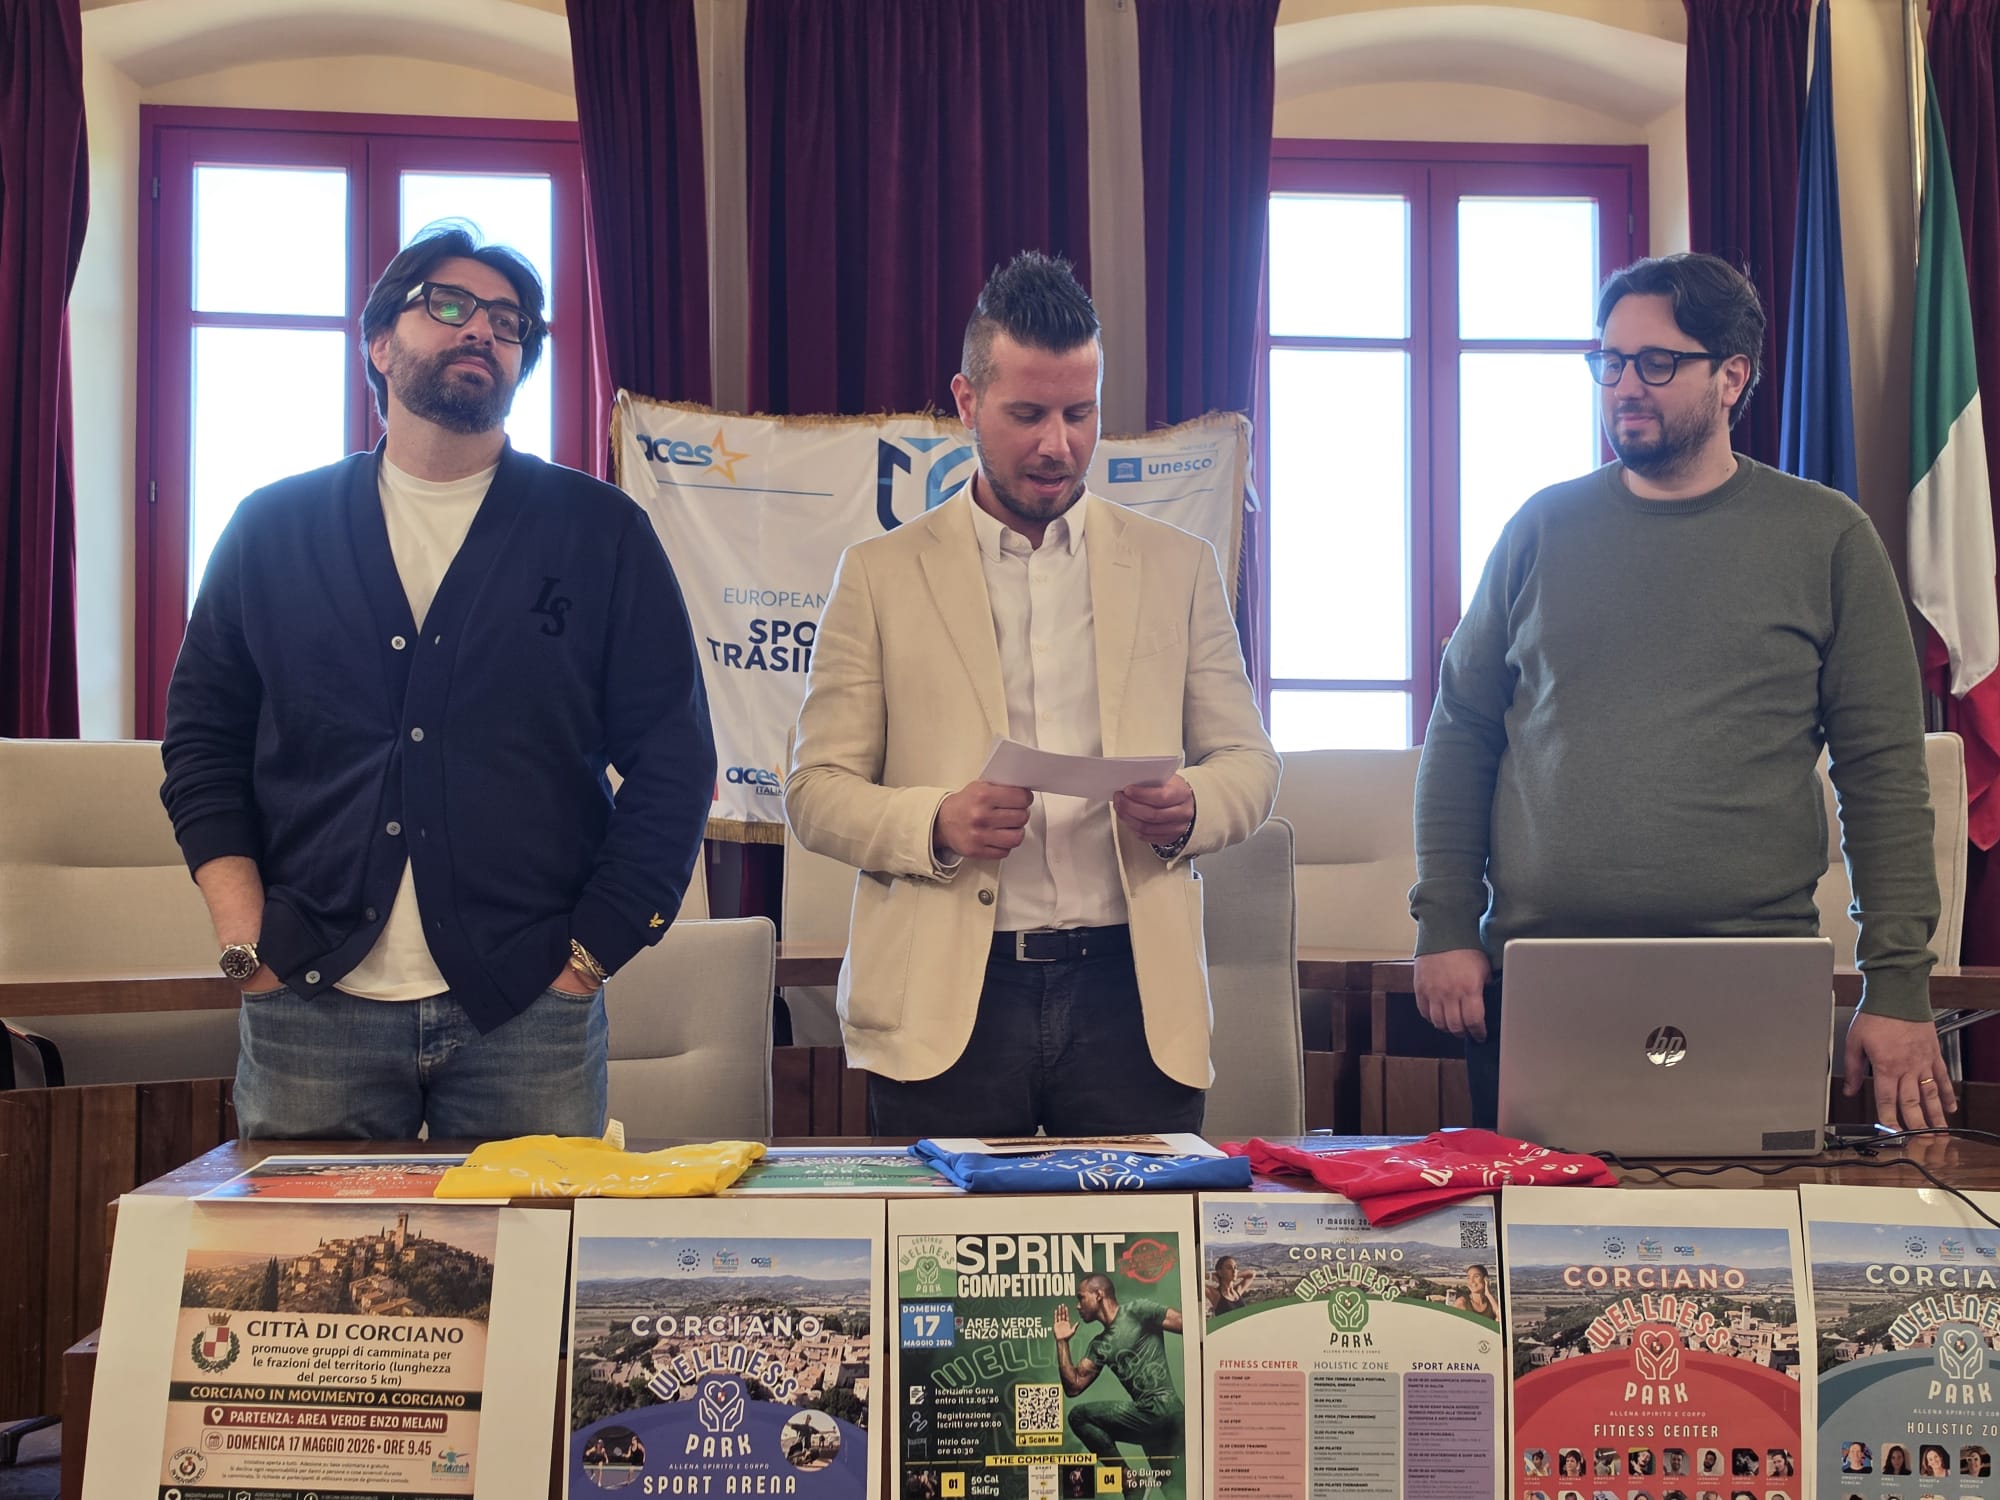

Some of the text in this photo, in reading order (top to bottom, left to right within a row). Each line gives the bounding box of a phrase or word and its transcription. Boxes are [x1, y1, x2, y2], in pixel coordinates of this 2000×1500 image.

[1148, 457, 1213, 475] unesco
[723, 587, 831, 609] EUROPEAN
[748, 618, 819, 647] SPO
[726, 767, 781, 787] aces
[900, 1244, 956, 1266] WELLNESS
[956, 1235, 1125, 1275] SPRINT
[1289, 1247, 1404, 1262] CORCIANO
[1294, 1261, 1401, 1302] WELLNESS
[1563, 1266, 1745, 1290] CORCIANO
[1865, 1263, 1998, 1289] CORCIA
[957, 1274, 1077, 1299] COMPETITION
[902, 1304, 954, 1313] DOMENICA
[631, 1315, 824, 1338] CORCIANO
[913, 1315, 941, 1337] 17
[966, 1317, 1042, 1329] AREA VERDE
[1584, 1293, 1730, 1350] WELLNESS
[1888, 1293, 2000, 1347] WELLNE
[246, 1318, 464, 1343] CITTÀ DI CORCIANO
[903, 1340, 953, 1348] MAGGIO 2026
[1329, 1332, 1374, 1348] PARK
[251, 1344, 452, 1362] promuove gruppi di camminata per
[253, 1358, 451, 1375] le frazioni del territorio (lunghezza
[647, 1343, 799, 1402] WELLNESS
[930, 1337, 1057, 1391] WELL
[1219, 1360, 1298, 1370] FITNESS CENTER
[1313, 1361, 1389, 1371] HOLISTIC ZONE
[1411, 1362, 1481, 1371] SPORT ARENA
[297, 1372, 401, 1387] del percorso 5 km)
[190, 1386, 465, 1407] CORCIANO IN MOVIMENTO A CORCIANO
[935, 1386, 994, 1397] Iscrizione Gara
[1623, 1382, 1689, 1406] PARK
[1927, 1379, 1992, 1405] PARK
[935, 1397, 957, 1406] entro
[959, 1396, 964, 1405] il
[230, 1411, 443, 1430] PARTENZA: AREA VERDE ENZO MELANI
[937, 1411, 991, 1422] Registrazione
[937, 1420, 1002, 1430] Iscritti ore 10:00
[1593, 1424, 1719, 1438] FITNESS CENTER
[1907, 1421, 1998, 1437] HOLISTIC ZO
[226, 1434, 432, 1457] DOMENICA 17 MAGGIO 2026 ORE 9.45
[685, 1433, 752, 1458] PARK
[937, 1436, 981, 1447] Inizio Gara
[1028, 1435, 1060, 1446] Scan Me
[937, 1448, 951, 1456] ore
[992, 1454, 1093, 1465] THE COMPETITION
[643, 1475, 797, 1495] SPORT ARENA
[948, 1478, 959, 1490] 01
[971, 1475, 999, 1487] 50 Cal
[1104, 1474, 1116, 1485] 04
[1126, 1480, 1138, 1489] To
[971, 1485, 1000, 1497] SkiErg
